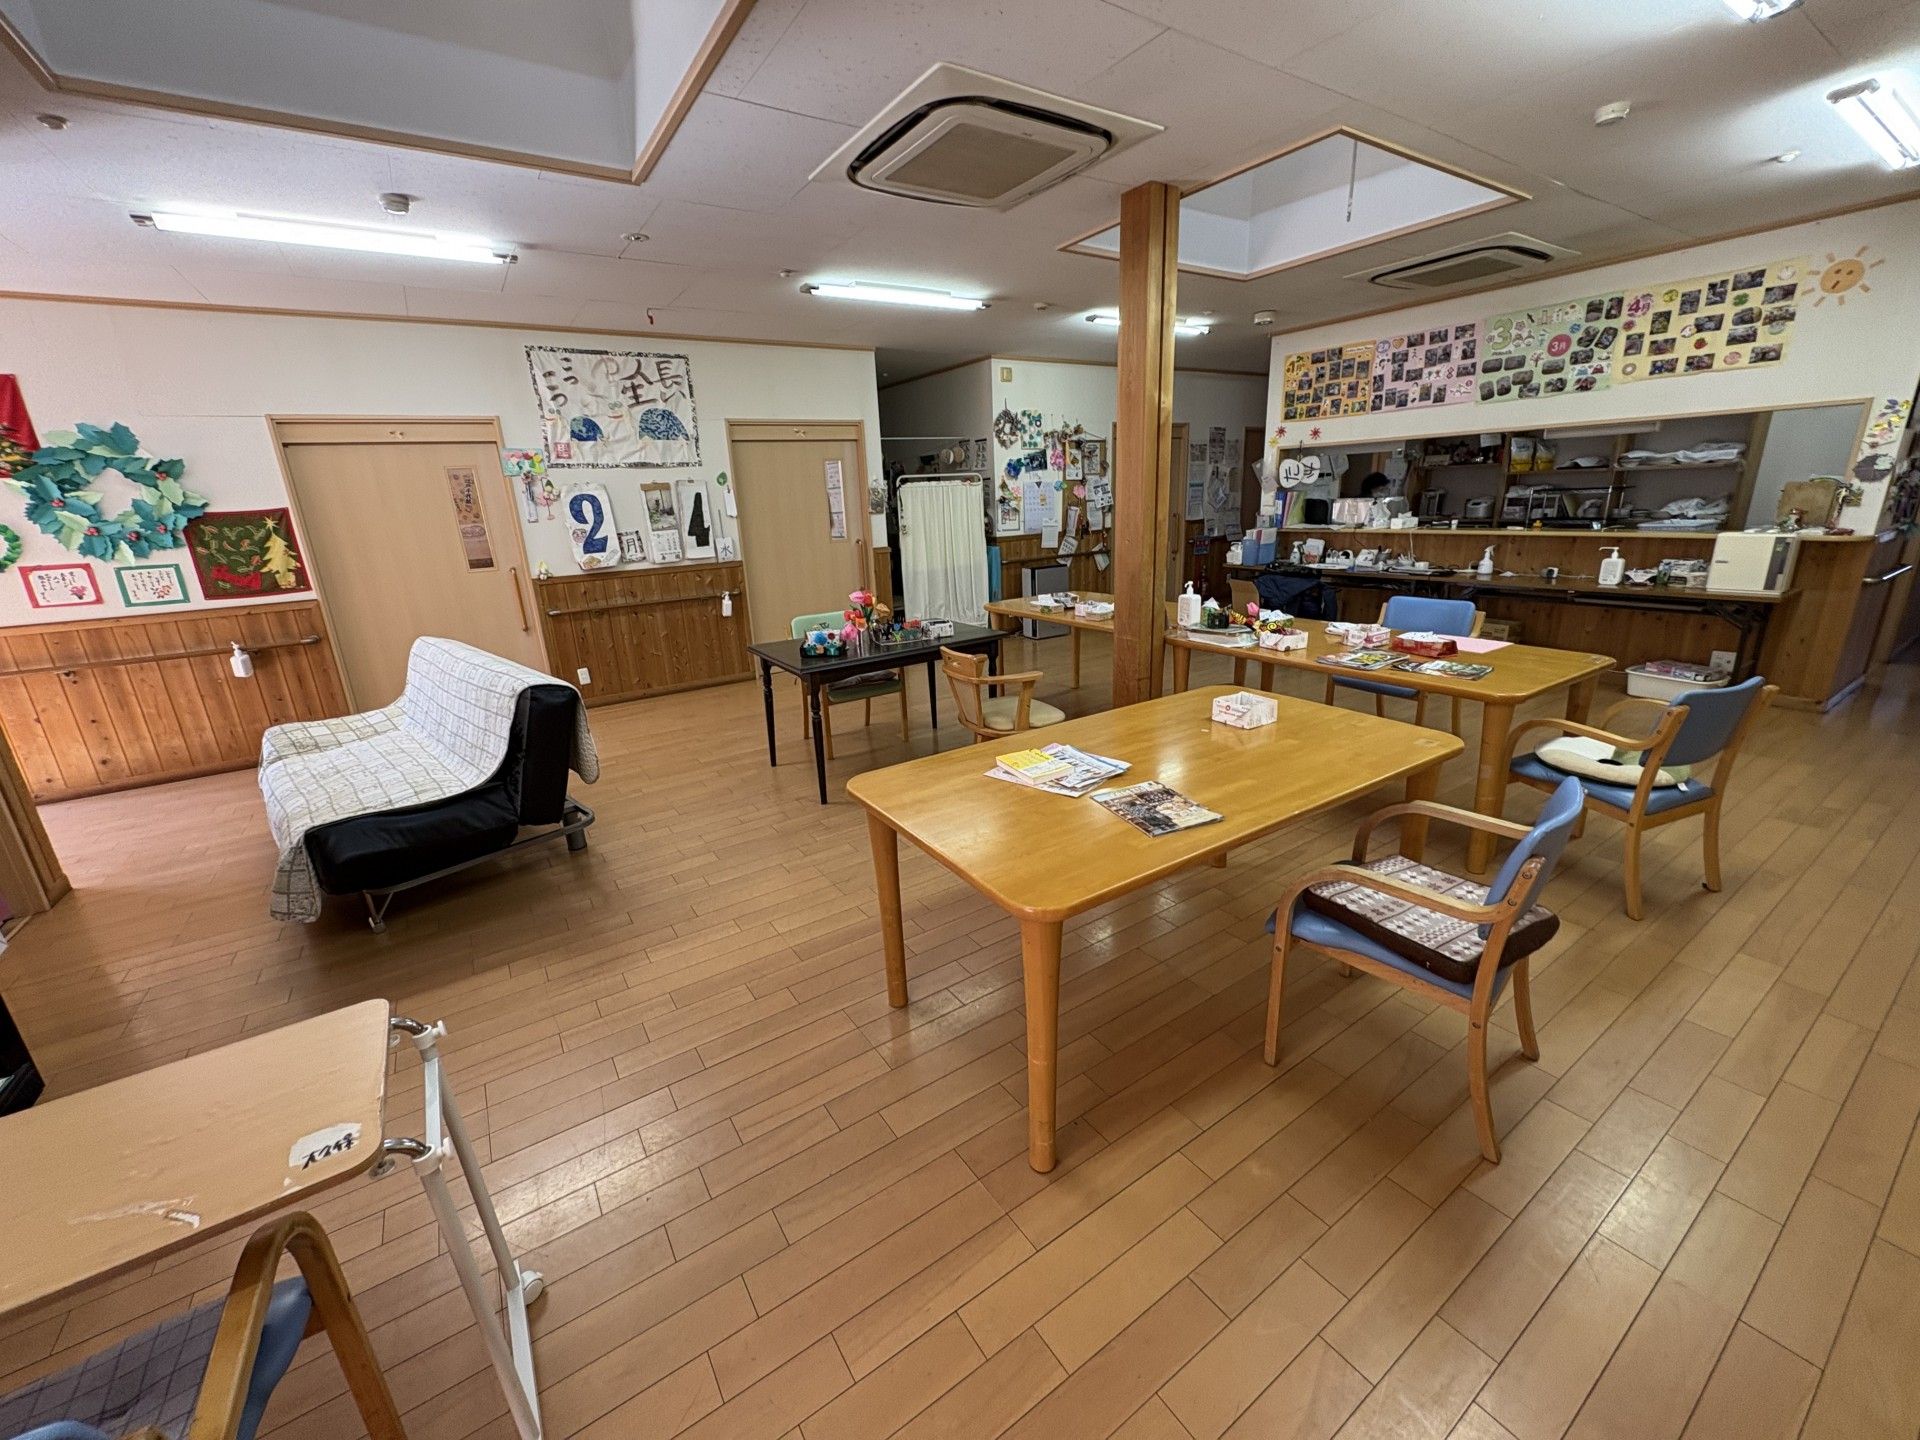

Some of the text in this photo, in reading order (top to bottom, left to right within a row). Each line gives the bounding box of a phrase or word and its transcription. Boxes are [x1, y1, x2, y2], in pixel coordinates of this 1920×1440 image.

[620, 358, 659, 409] 人生
[650, 359, 688, 403] 長い
[569, 493, 609, 554] 2
[688, 492, 711, 547] 4
[626, 537, 637, 553] 月
[720, 544, 733, 557] 水
